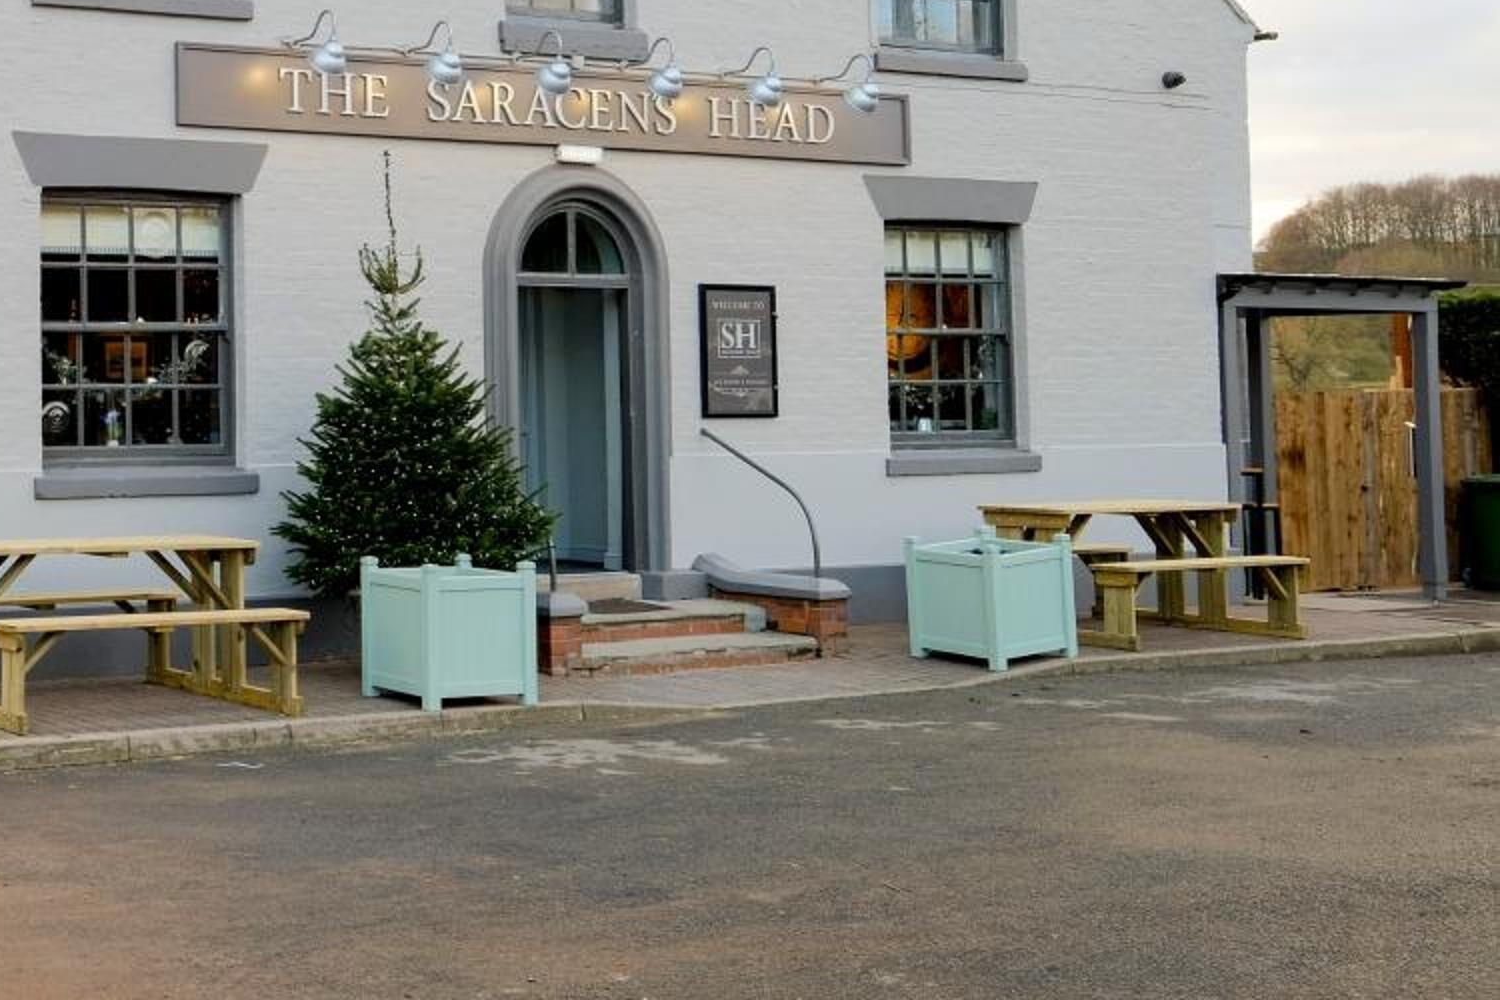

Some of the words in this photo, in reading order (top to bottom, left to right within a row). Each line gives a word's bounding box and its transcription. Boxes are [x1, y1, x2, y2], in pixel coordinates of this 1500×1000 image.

[280, 67, 389, 118] THE
[708, 97, 836, 144] HEAD
[721, 322, 756, 348] SH
